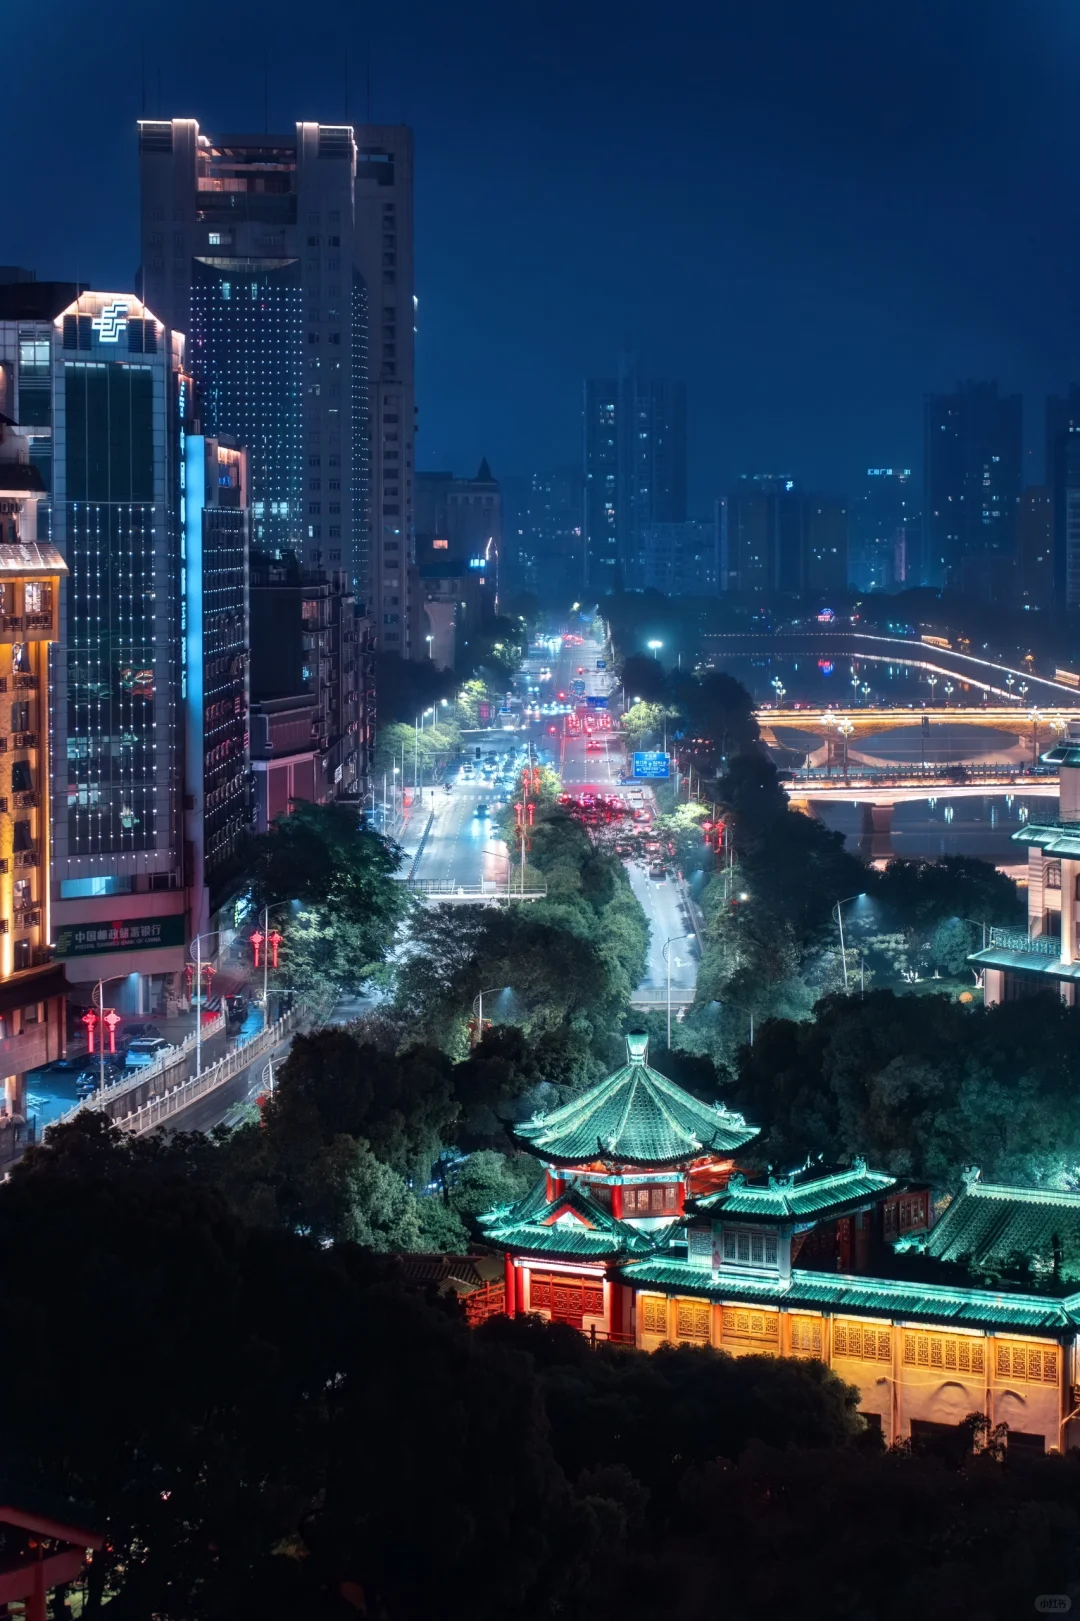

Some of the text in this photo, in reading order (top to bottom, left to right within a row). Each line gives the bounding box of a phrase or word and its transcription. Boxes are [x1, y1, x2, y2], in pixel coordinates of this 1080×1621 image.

[75, 924, 162, 943] 中国邮政储蓄银行
